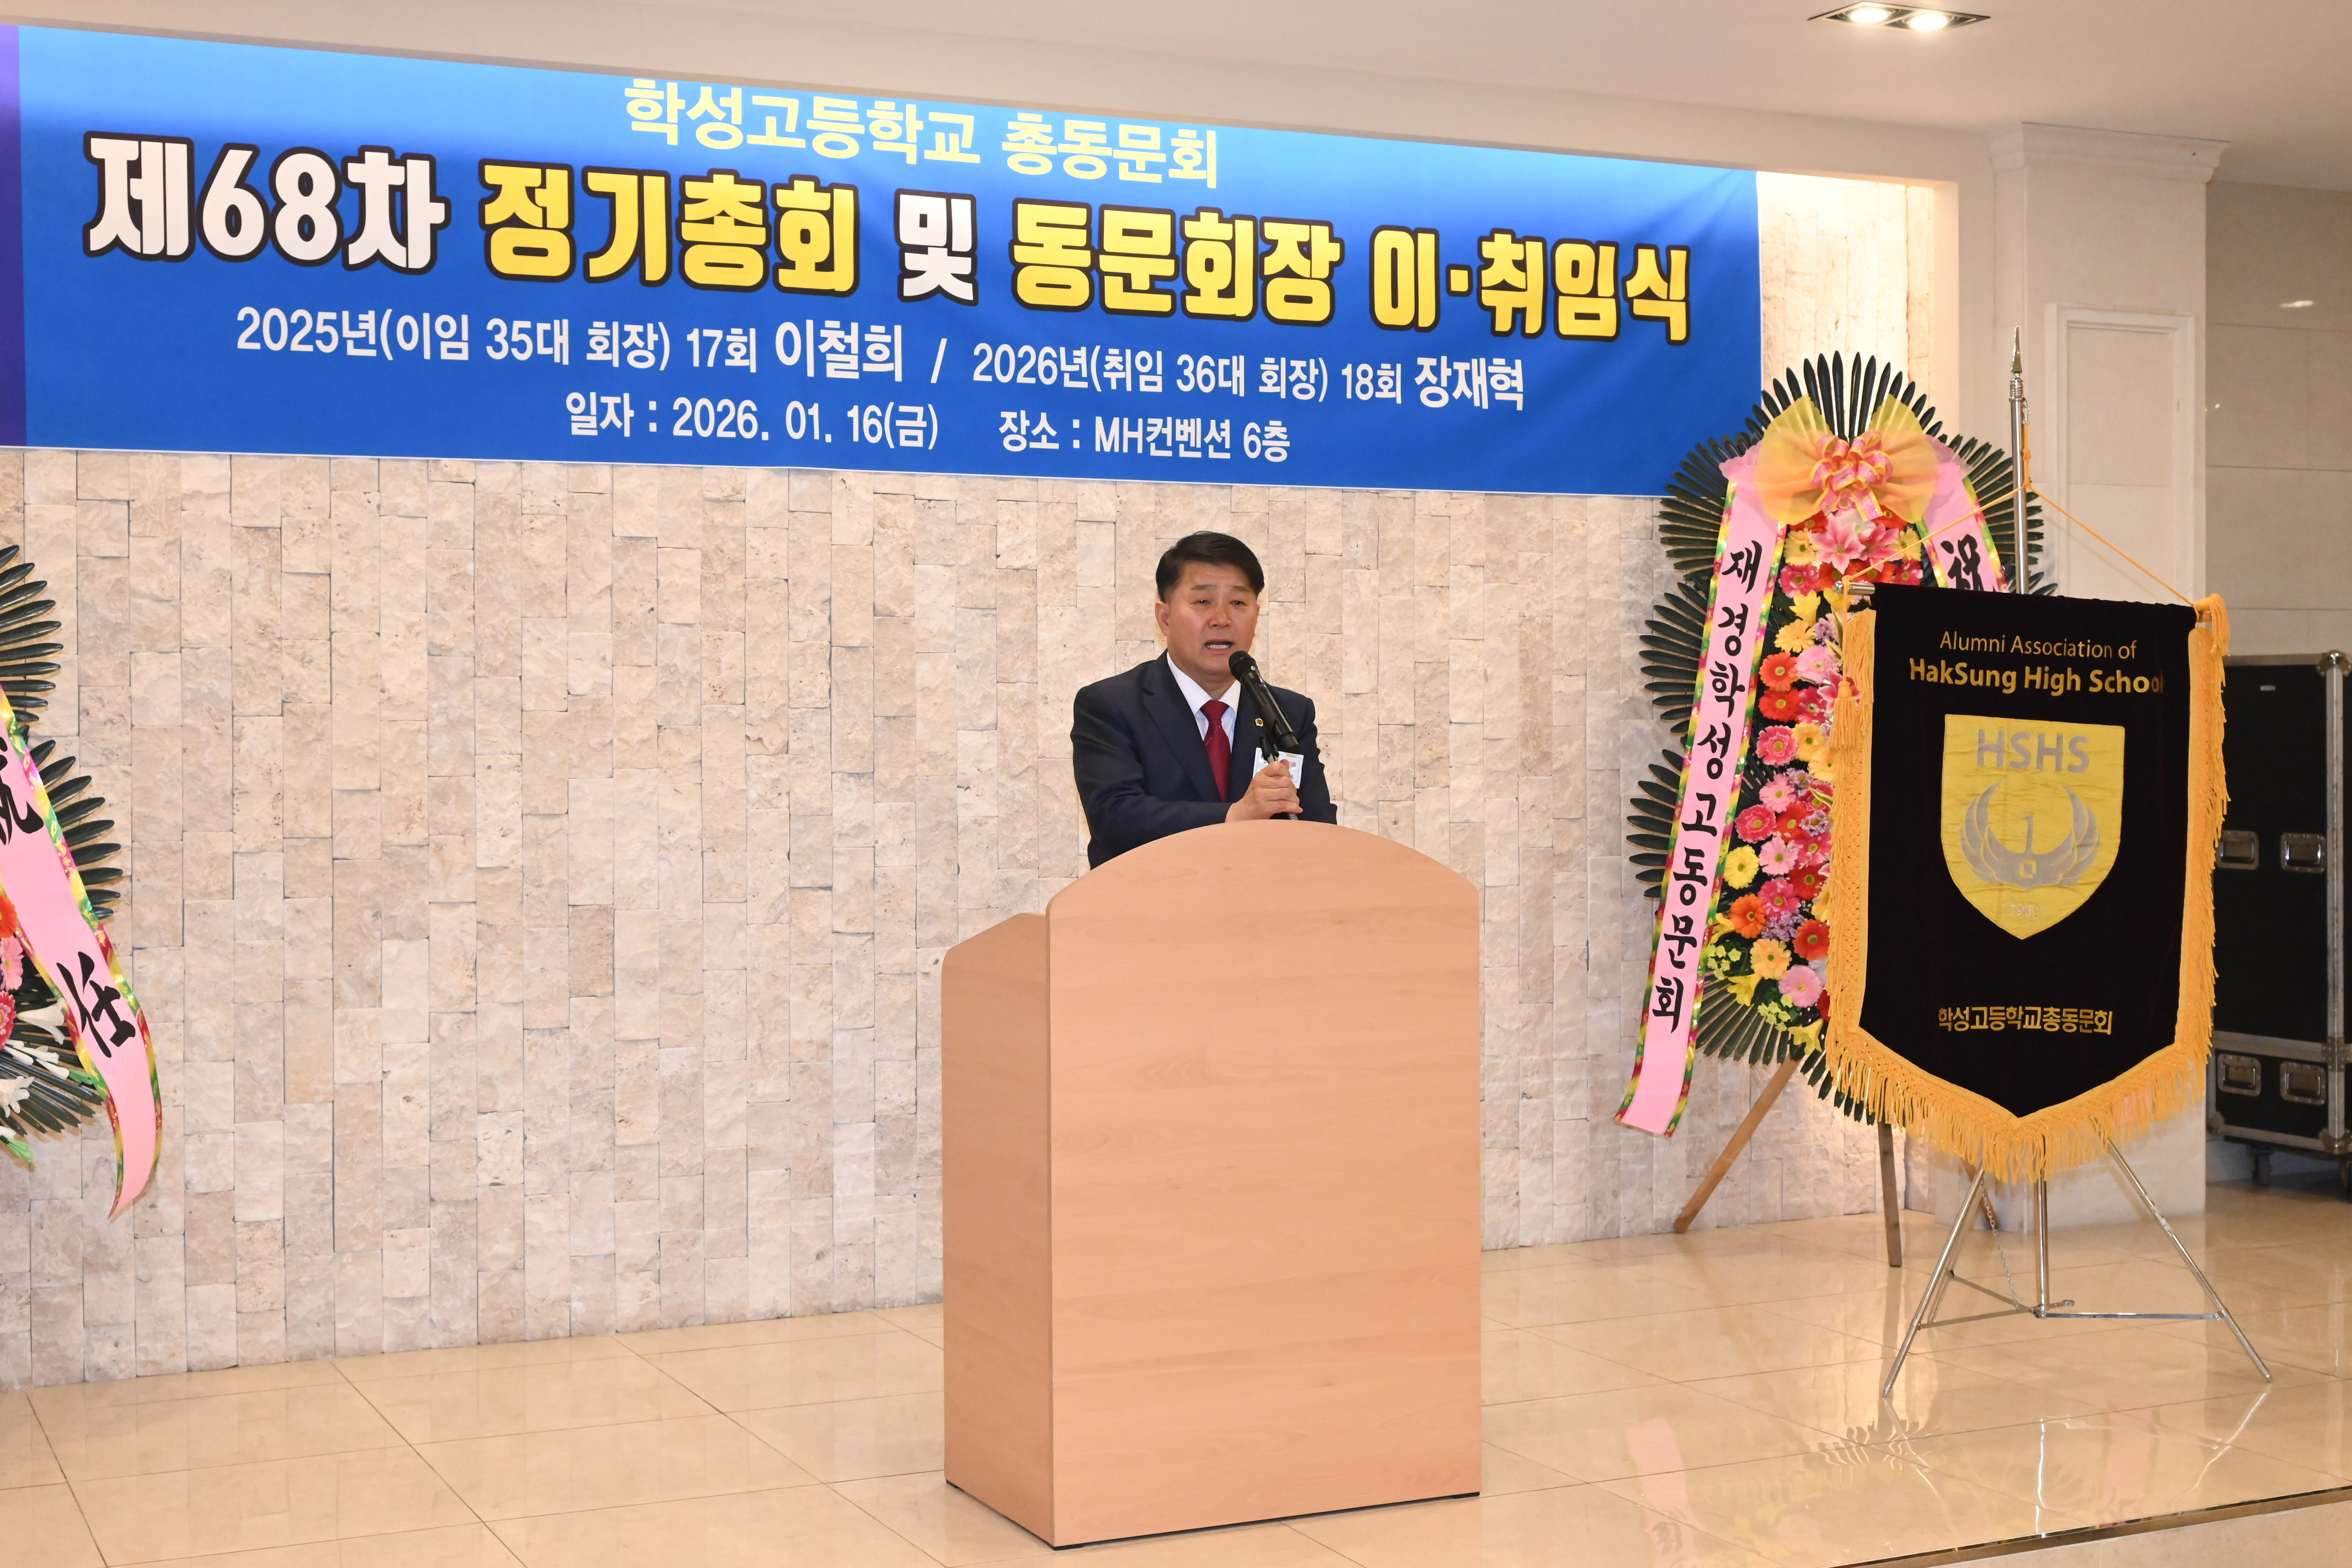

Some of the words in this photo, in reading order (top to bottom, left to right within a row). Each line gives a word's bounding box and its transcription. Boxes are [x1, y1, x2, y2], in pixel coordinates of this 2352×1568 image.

[624, 79, 981, 165] 학성고등학교
[1001, 112, 1218, 189] 총동문회
[83, 131, 451, 275] 제68차
[479, 159, 860, 297] 정기총회
[895, 189, 979, 306] 및
[1009, 198, 1345, 327] 동문회장
[237, 307, 469, 360] 2025년(이임
[486, 318, 569, 365] 35대
[586, 321, 670, 371] 회장)
[687, 328, 756, 373] 17회
[775, 318, 902, 382] 이철희
[973, 342, 1162, 393] 2026년(취임
[1177, 354, 1244, 397] 36대
[1259, 357, 1328, 402] 회장)
[1342, 363, 1402, 404] 18회
[1414, 356, 1523, 411] 장재혁
[673, 397, 769, 440] 2026.
[786, 400, 831, 443] 01.
[847, 402, 938, 450] 16(금)
[1095, 416, 1231, 459] MH컨벤션
[1243, 420, 1290, 462] 6층
[1940, 631, 2005, 653] Alumni
[2011, 635, 2113, 658] Association
[2118, 640, 2138, 659] of
[1909, 657, 2017, 694] HakSung
[2024, 666, 2081, 696] High
[2089, 669, 2163, 694] School
[1977, 729, 2090, 774] HSHS
[1939, 1006, 2113, 1035] 학성고등학교총동문회
